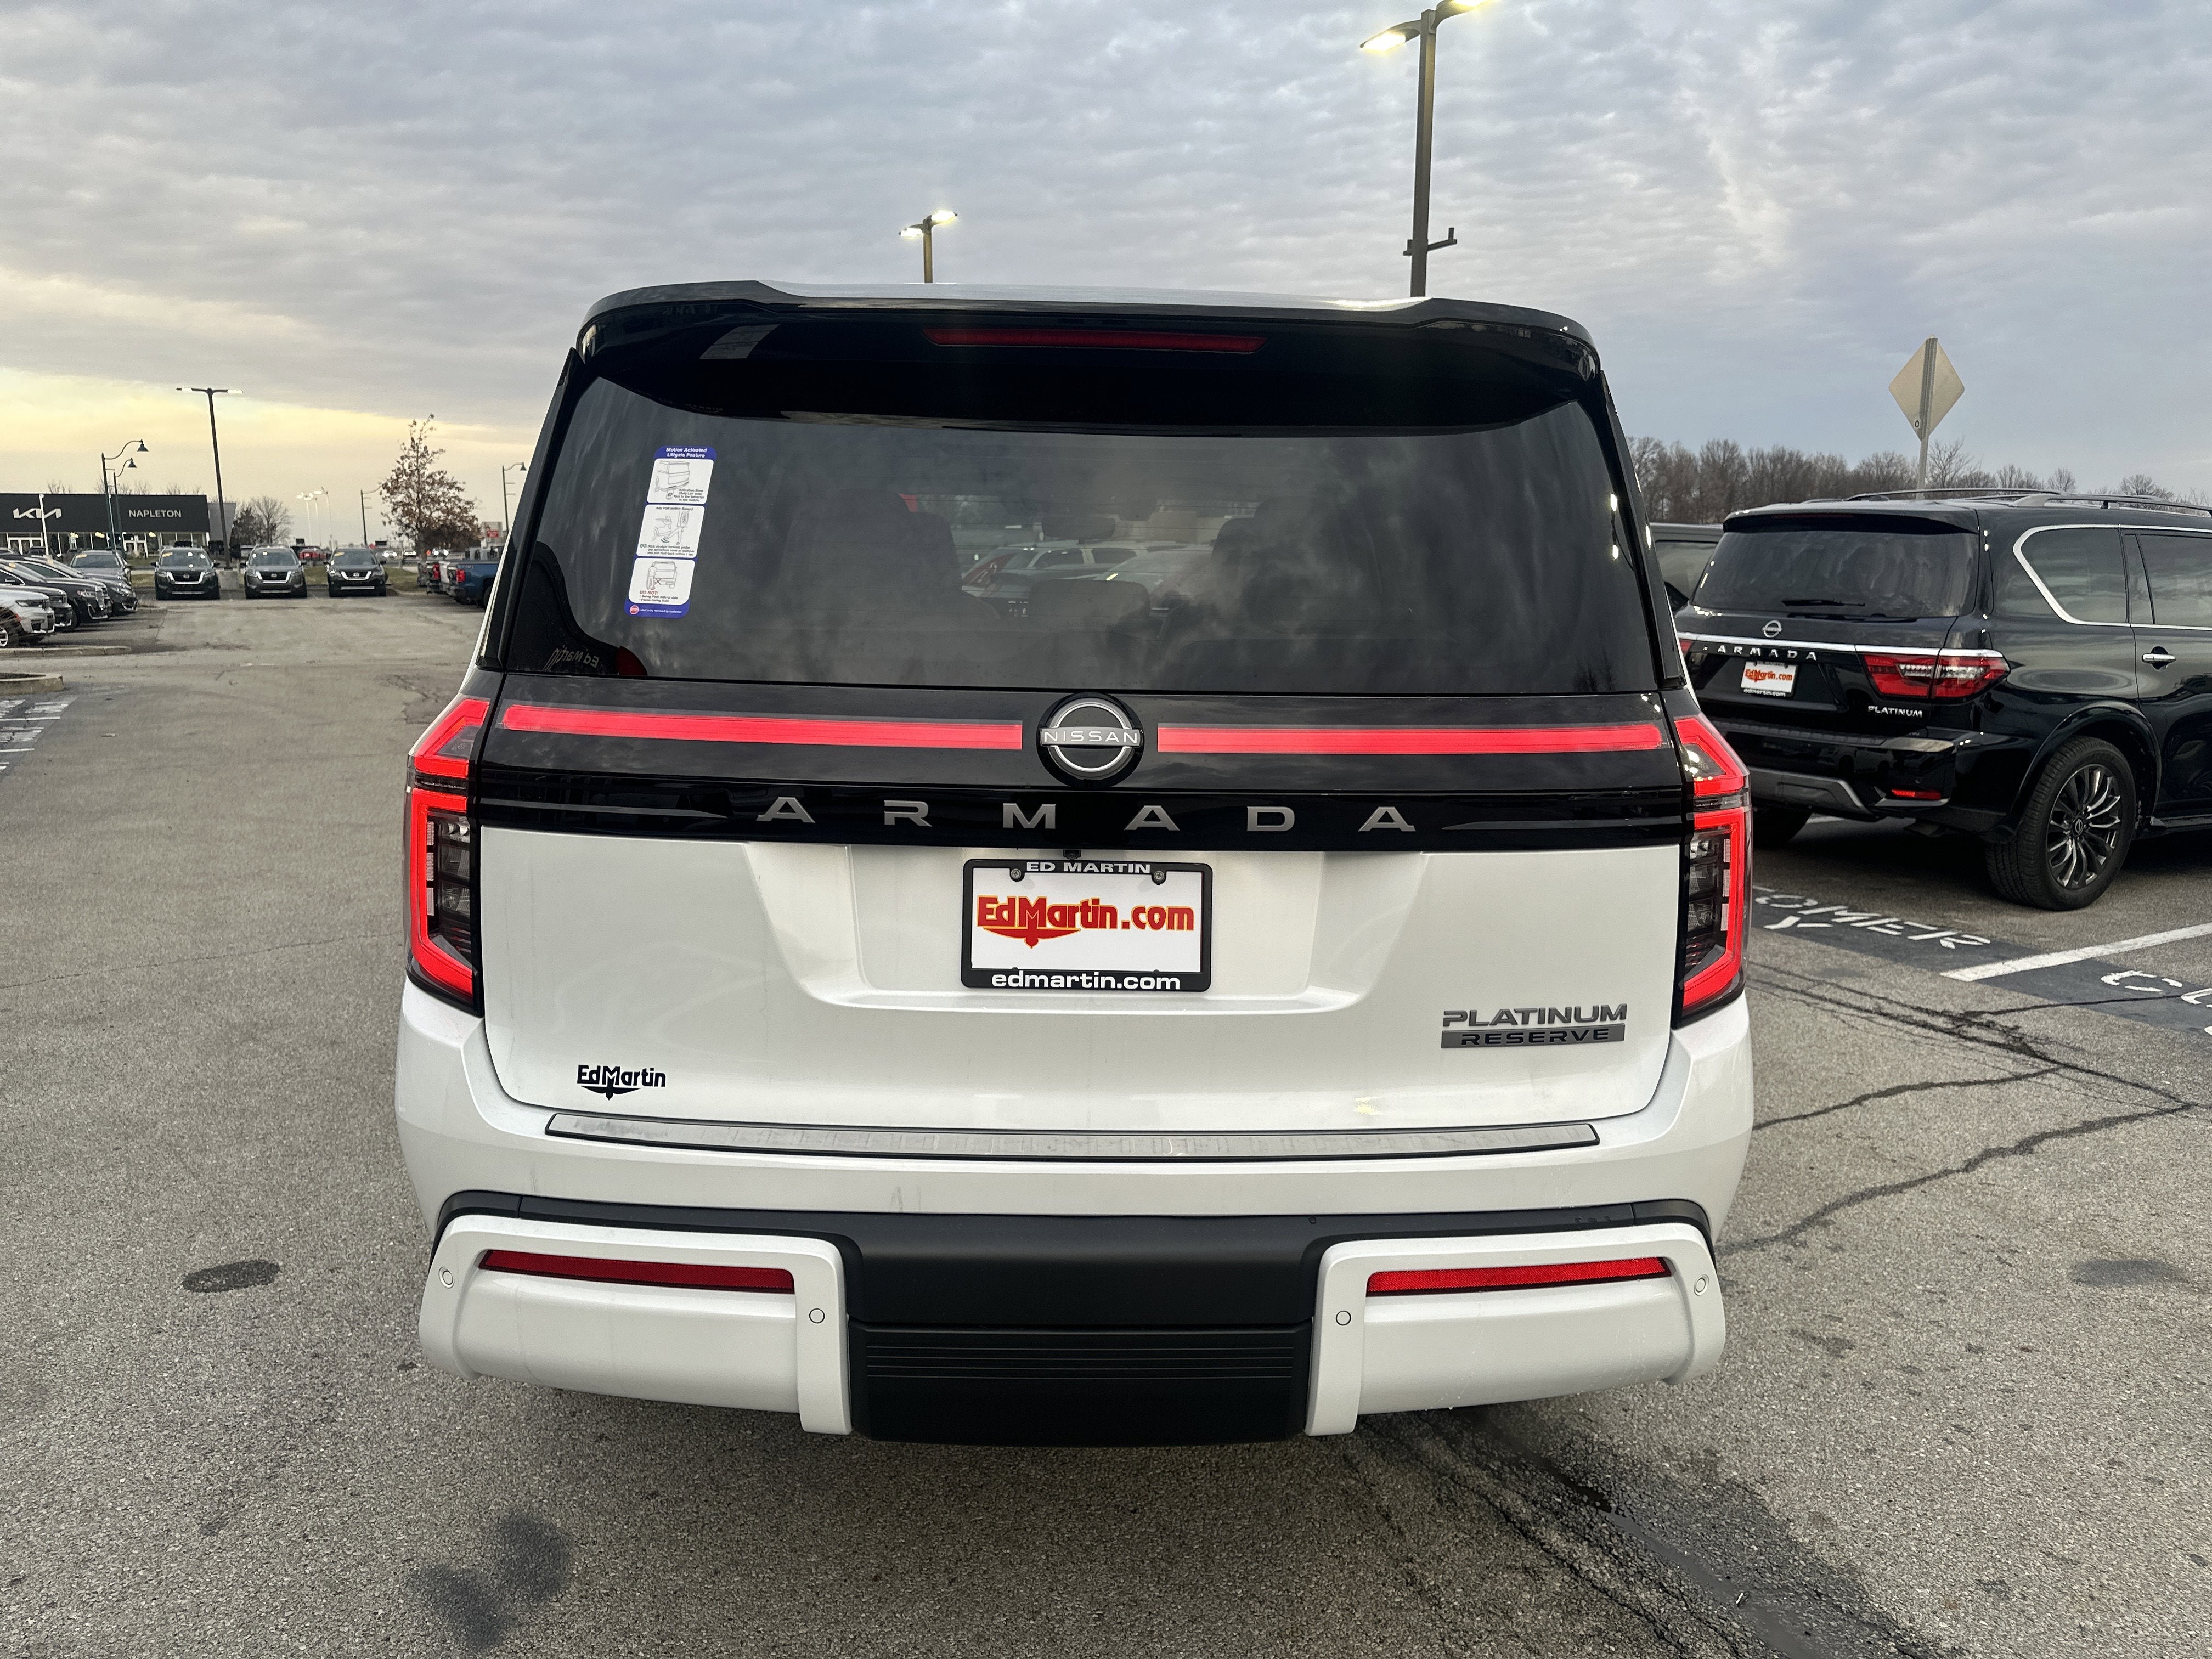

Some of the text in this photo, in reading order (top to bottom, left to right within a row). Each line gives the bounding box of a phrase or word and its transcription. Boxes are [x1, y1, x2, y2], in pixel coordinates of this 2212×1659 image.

[128, 509, 182, 518] NAPLETON
[1717, 645, 1817, 661] ARMADA
[1744, 669, 1793, 681] EdMartin.com
[1867, 705, 1922, 718] PLATINUM
[1043, 730, 1138, 744] NISSAN
[755, 796, 1417, 832] ARMADA
[1026, 862, 1151, 874] ED MARTIN
[977, 895, 1194, 932] EdMartin.com
[991, 970, 1181, 990] edmartin.com
[1443, 1003, 1628, 1027] PLATINUM
[1461, 1028, 1609, 1046] RESERVE
[577, 1064, 666, 1087] EdMartin
